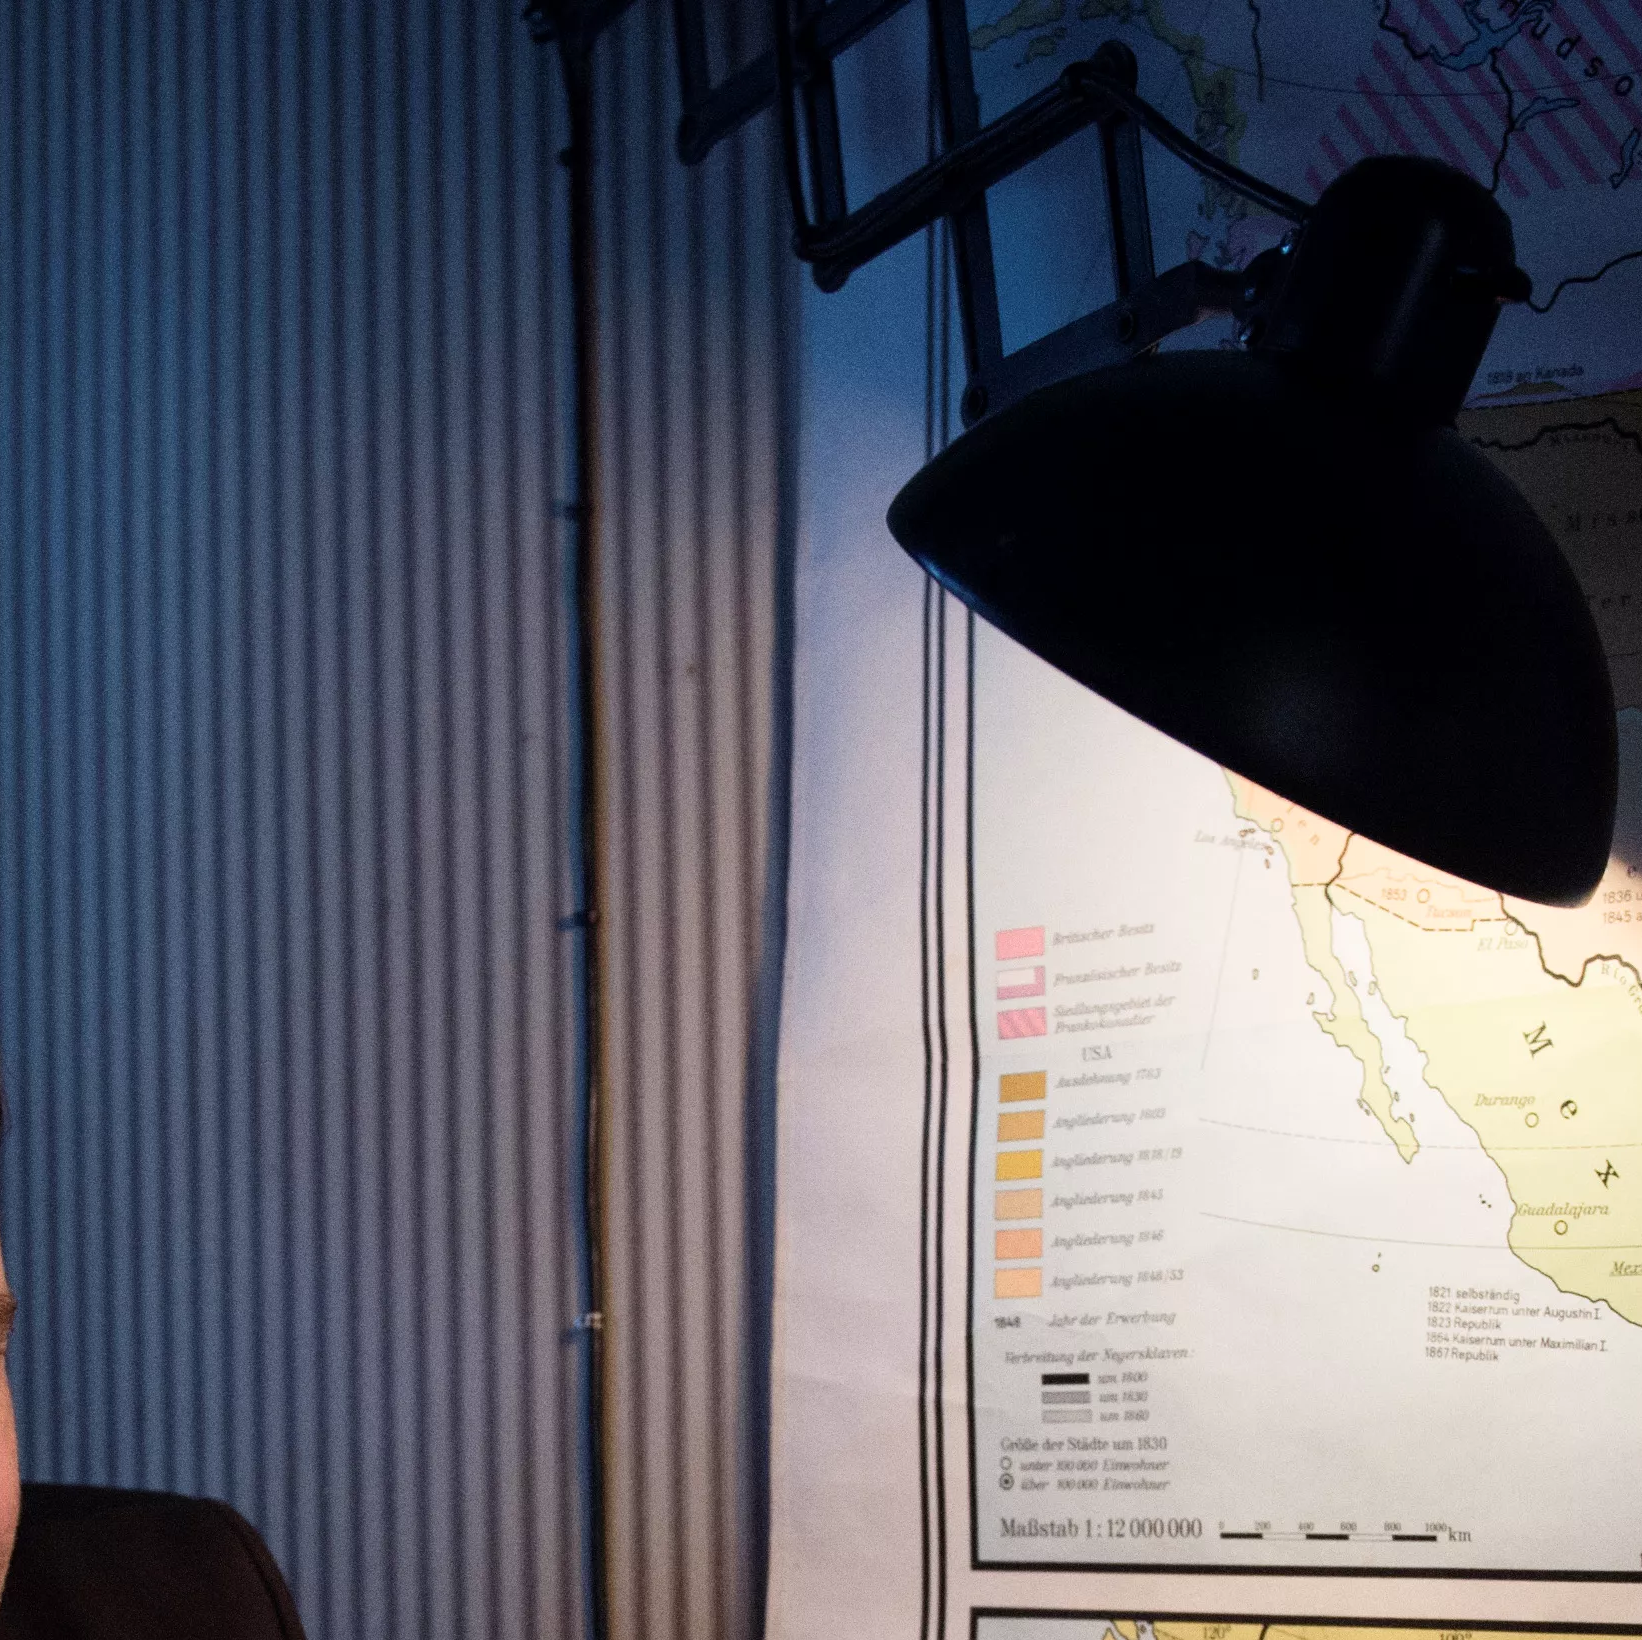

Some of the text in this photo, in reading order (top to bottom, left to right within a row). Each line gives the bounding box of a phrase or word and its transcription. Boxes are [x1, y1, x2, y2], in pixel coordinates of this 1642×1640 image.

[1475, 1094, 1535, 1108] Durango
[1518, 1203, 1609, 1218] Guadalajara
[1429, 1287, 1520, 1303] 1821 selbständig
[1427, 1317, 1501, 1330] 1823 Republik
[1426, 1347, 1498, 1362] 1867 Republik
[1000, 1437, 1167, 1450] Größe der Städte um 1830
[1000, 1518, 1078, 1538] Maßstab
[1448, 1528, 1471, 1542] km
